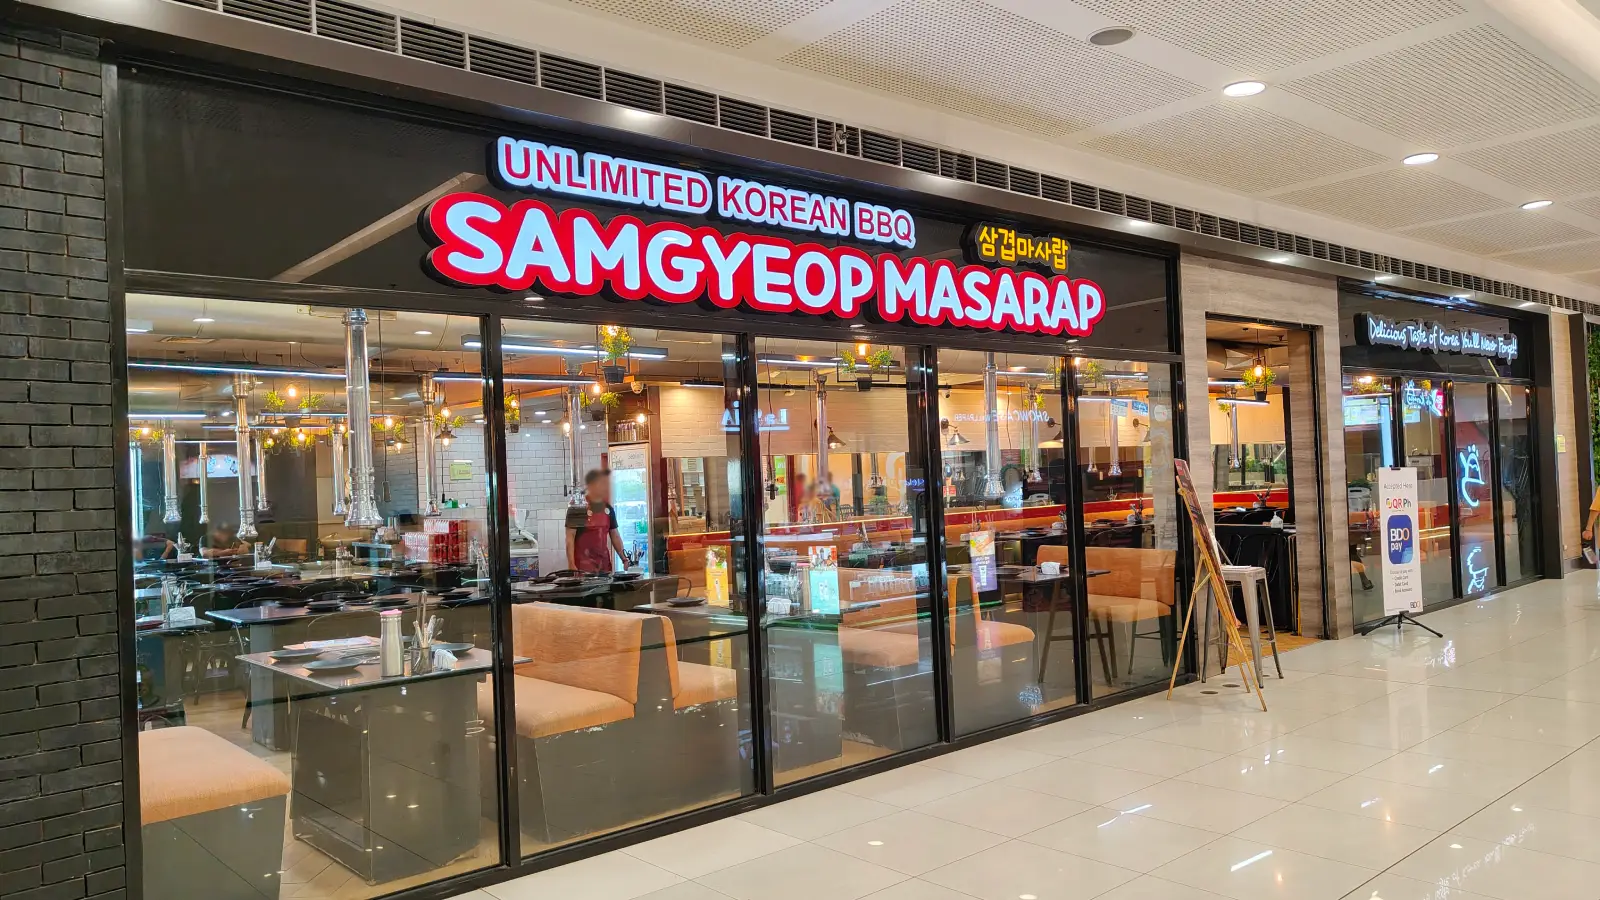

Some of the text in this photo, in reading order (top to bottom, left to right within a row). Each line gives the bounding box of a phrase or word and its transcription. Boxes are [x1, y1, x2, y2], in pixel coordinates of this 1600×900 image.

[504, 142, 913, 242] UNLIMITED KOREAN BBQ
[978, 226, 1069, 271] 삼겹마사랍
[445, 200, 1102, 331] SAMGYEOP MASARAP
[1368, 317, 1407, 344] Delicious
[1407, 324, 1428, 345] Taste
[1429, 325, 1438, 348] of
[1439, 328, 1460, 347] Korea
[1480, 336, 1498, 352] Never
[1498, 336, 1518, 358] Forget!
[1384, 482, 1403, 492] Accepted
[1392, 498, 1412, 509] QR Ph
[1389, 527, 1410, 542] BDO
[1390, 541, 1403, 553] pay
[1410, 601, 1421, 609] BDO
